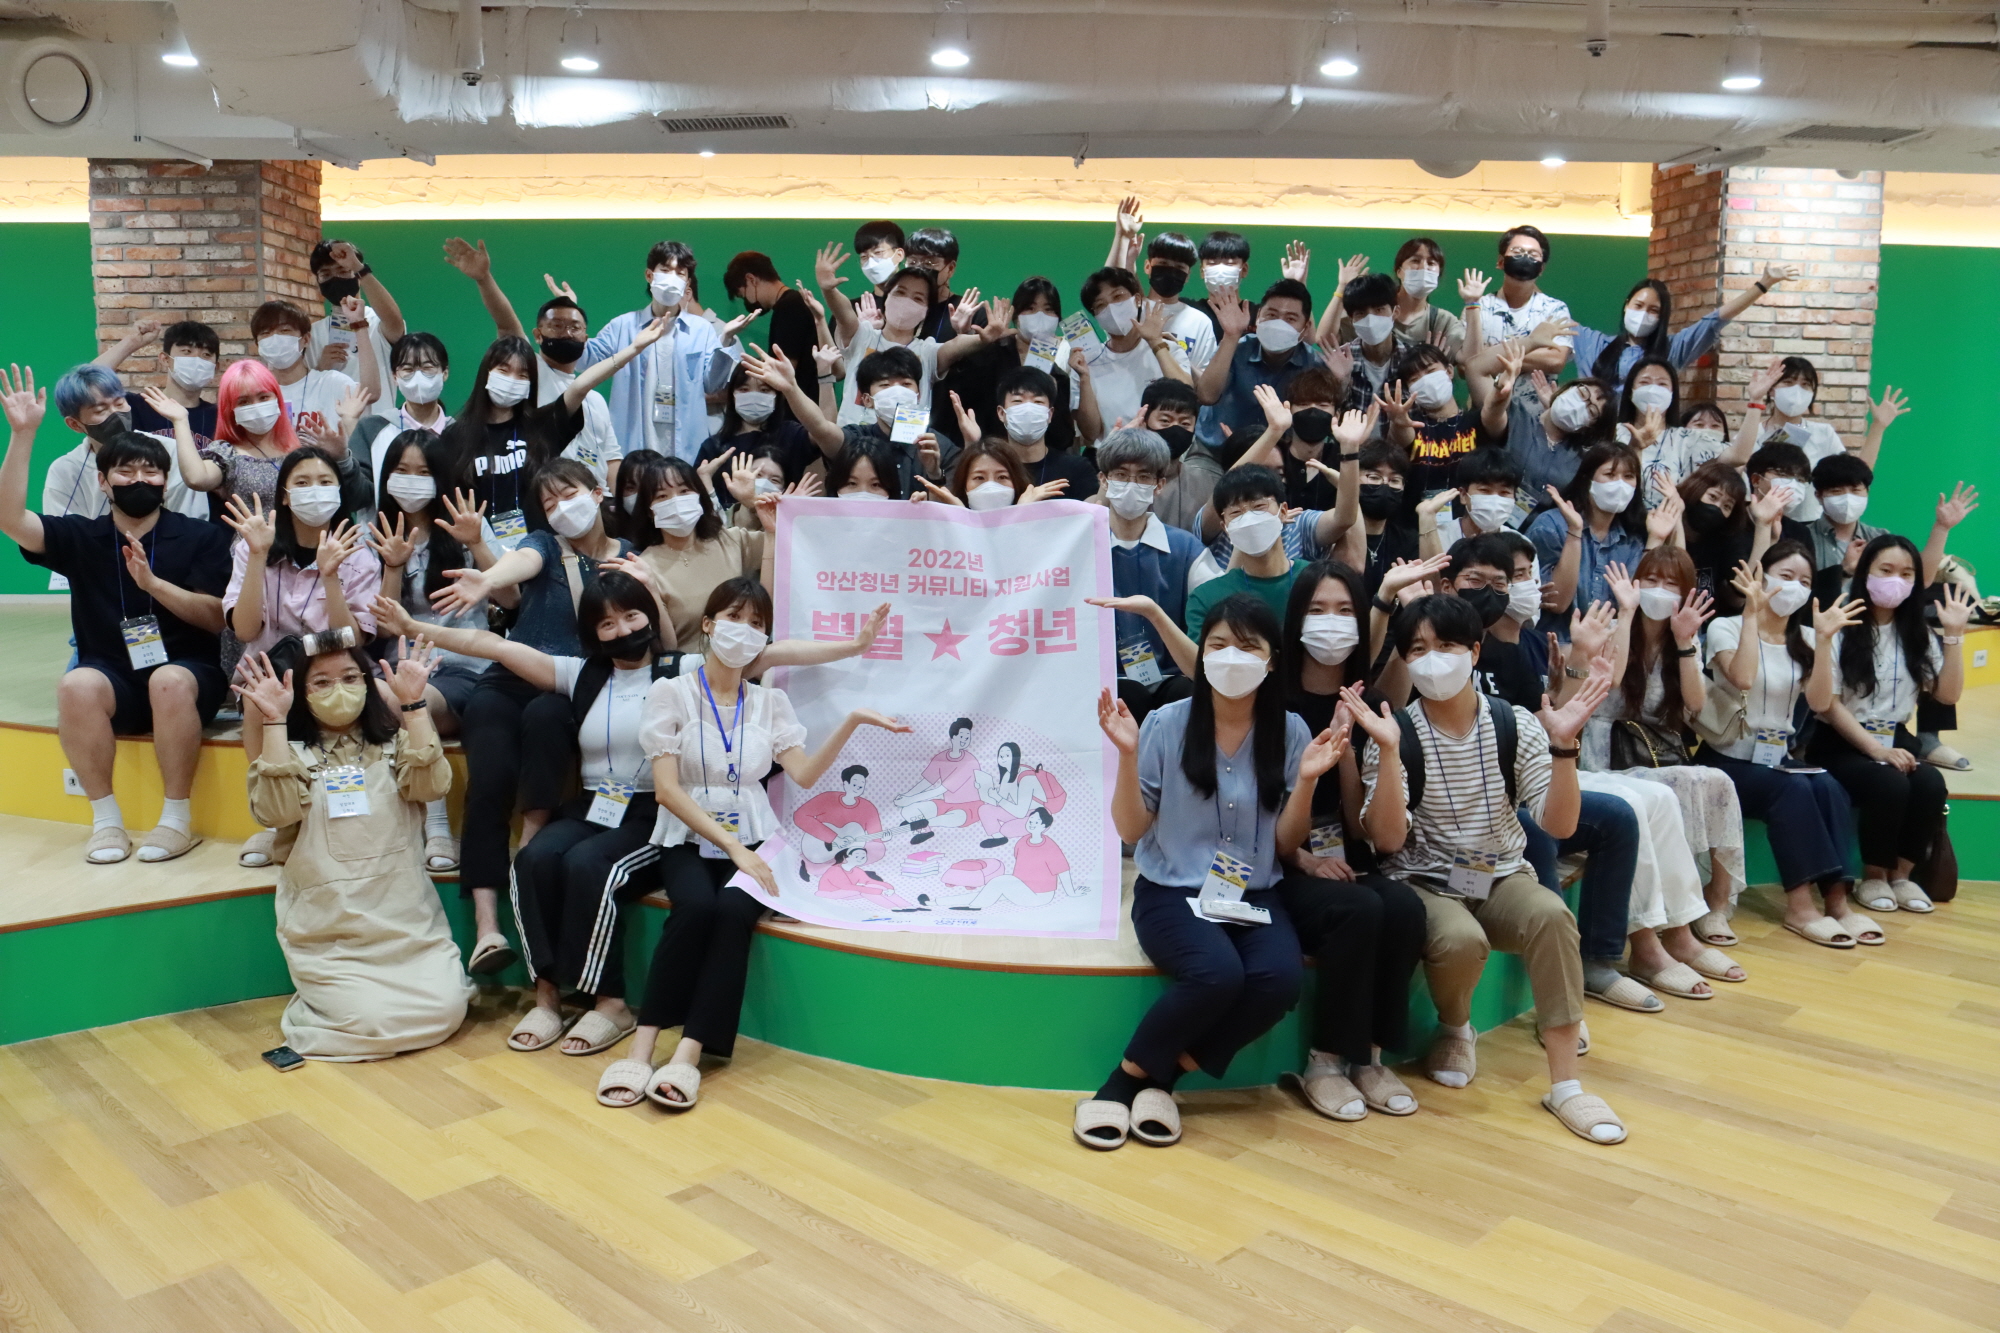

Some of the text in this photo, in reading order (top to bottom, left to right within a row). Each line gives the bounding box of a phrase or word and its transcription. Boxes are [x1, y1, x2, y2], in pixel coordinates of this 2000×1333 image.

[908, 548, 984, 573] 2022년
[816, 566, 1070, 598] 안산청년 커뮤니티 지원사업
[988, 607, 1078, 657] 청년
